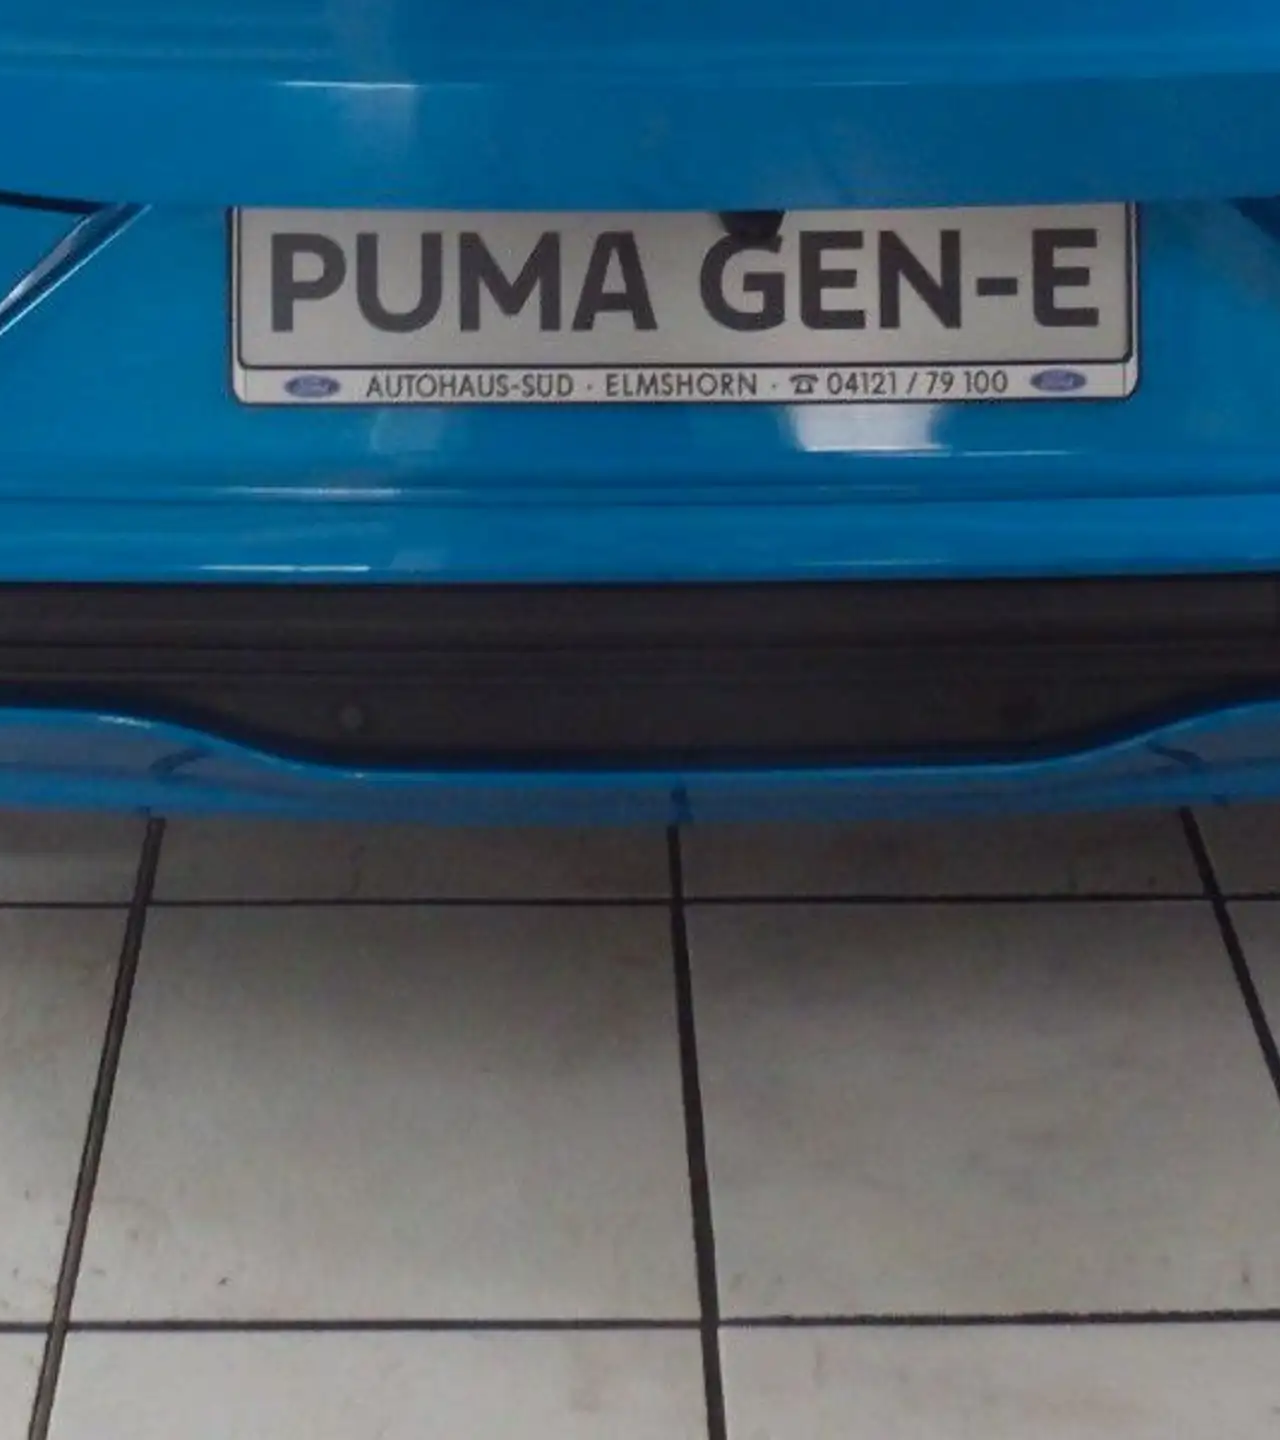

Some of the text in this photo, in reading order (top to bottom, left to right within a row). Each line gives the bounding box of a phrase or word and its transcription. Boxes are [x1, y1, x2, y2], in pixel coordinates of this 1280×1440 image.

[271, 228, 1100, 333] PUMA GEN-E
[605, 371, 758, 397] ELMSHORN
[825, 370, 897, 395] 04121
[926, 369, 954, 394] 79
[964, 368, 1009, 392] 100
